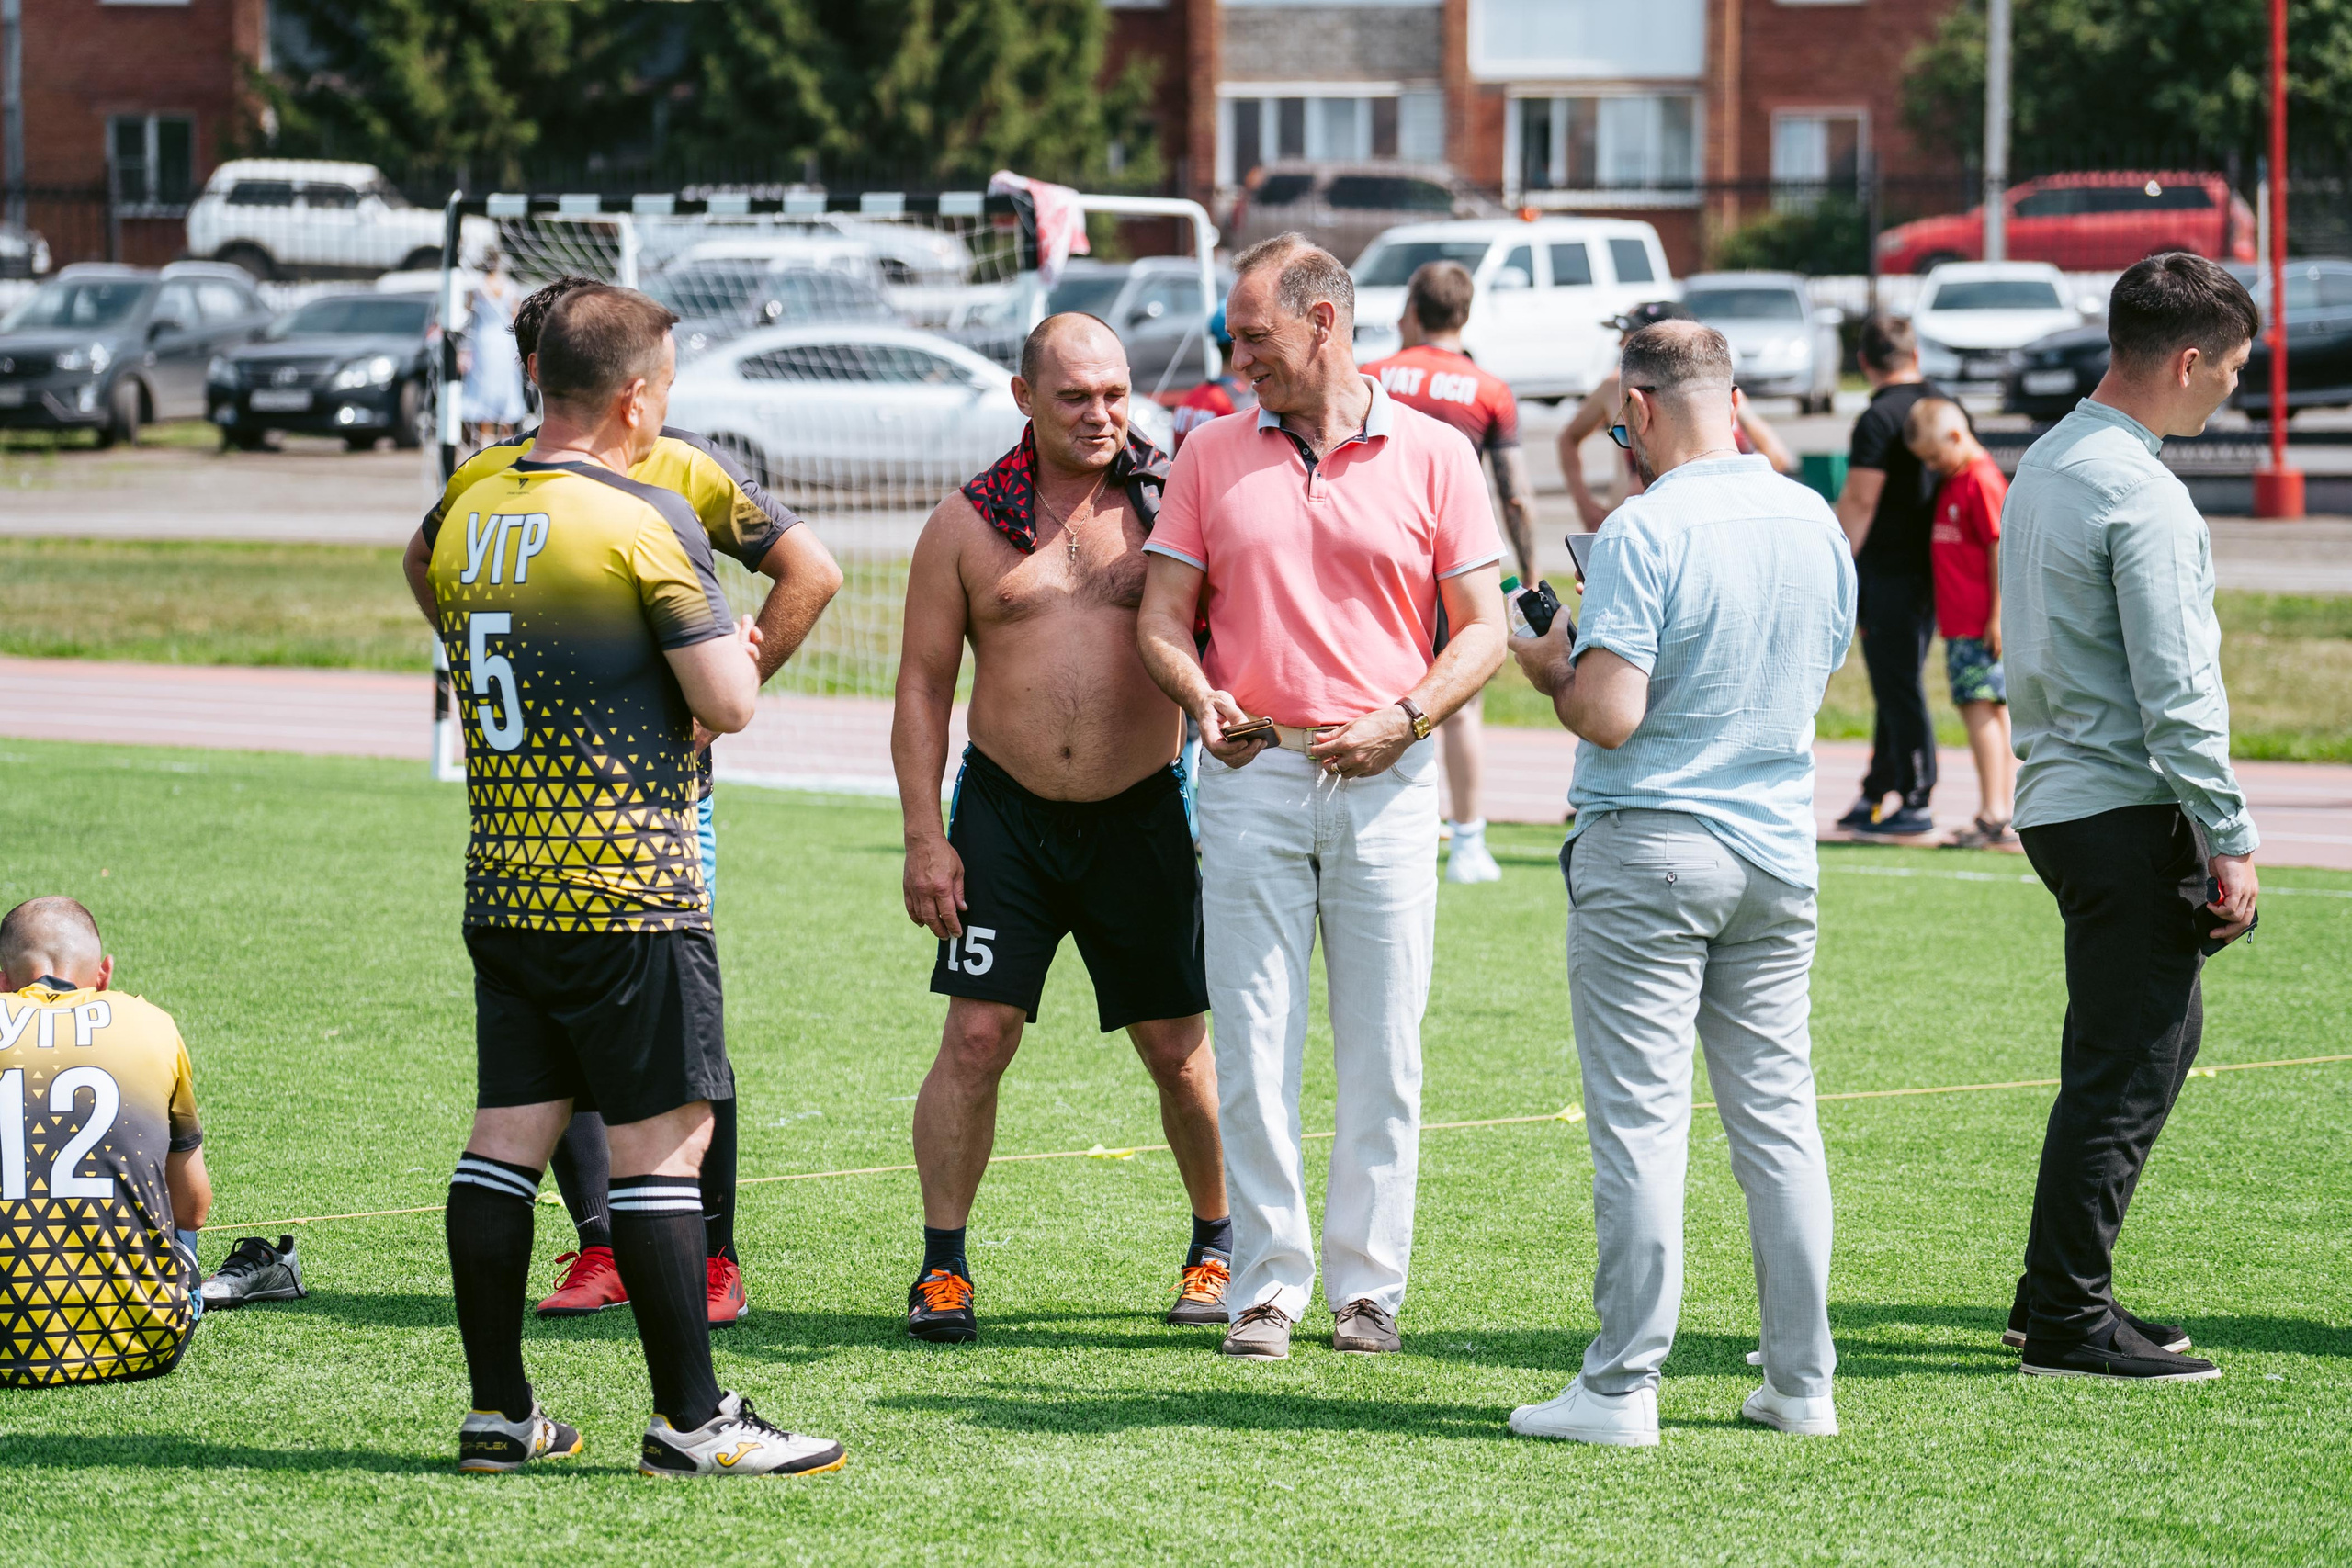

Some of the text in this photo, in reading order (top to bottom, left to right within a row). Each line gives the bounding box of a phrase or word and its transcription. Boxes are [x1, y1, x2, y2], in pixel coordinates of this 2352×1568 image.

[460, 512, 550, 585] УГР
[469, 611, 525, 751] 5
[947, 925, 996, 976] 15
[0, 1066, 120, 1200] 12
